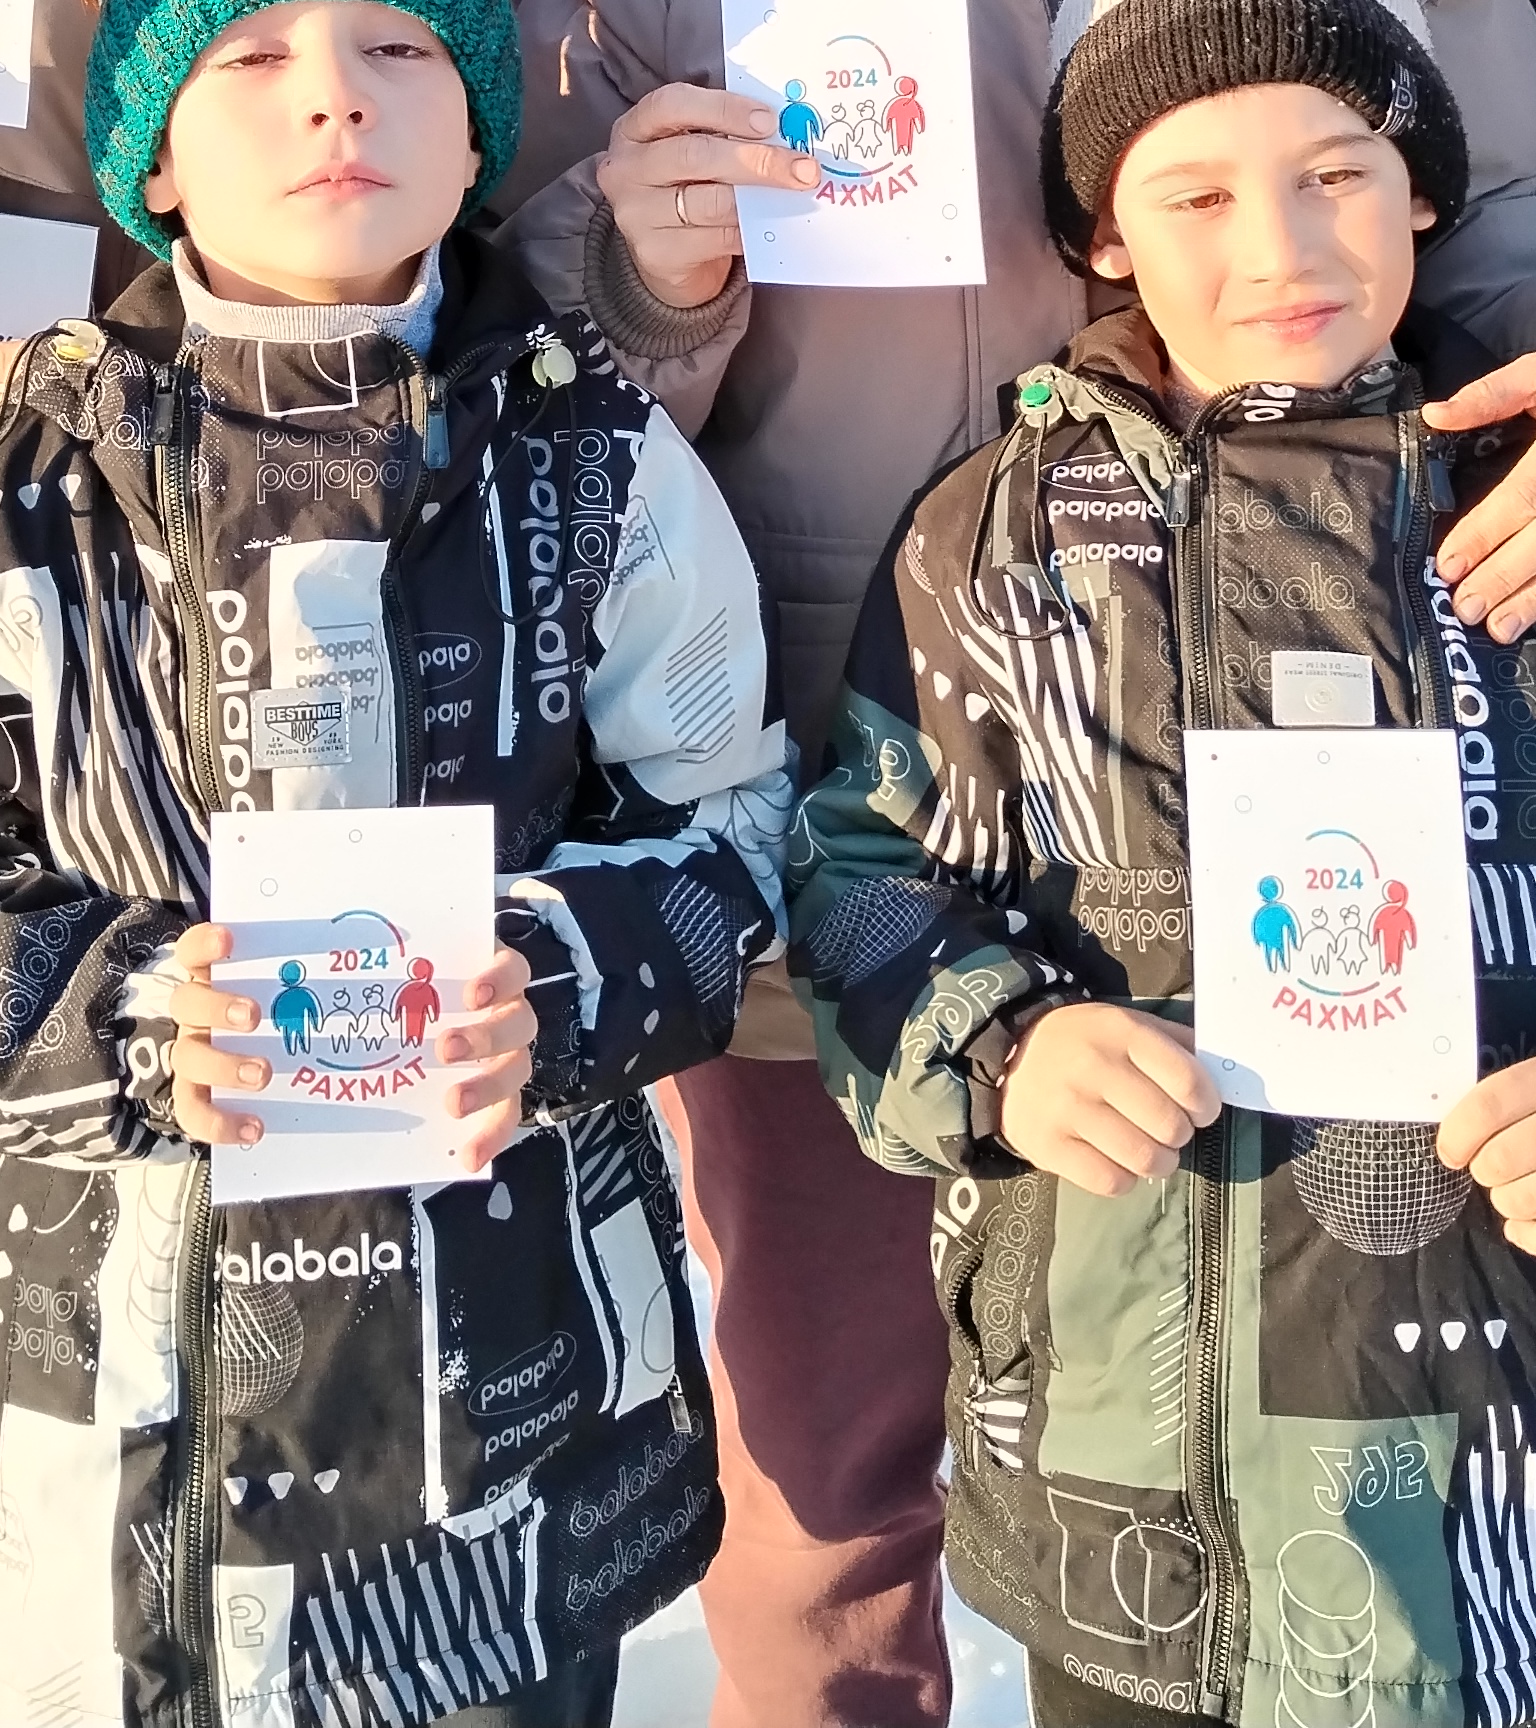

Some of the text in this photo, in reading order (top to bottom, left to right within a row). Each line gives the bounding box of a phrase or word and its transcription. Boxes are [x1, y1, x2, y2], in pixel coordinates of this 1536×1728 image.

[825, 68, 879, 90] 2024
[816, 163, 919, 207] АХМАТ
[265, 703, 342, 723] BESTTIME
[290, 720, 319, 742] BOYS
[265, 748, 299, 756] FASHION
[1305, 868, 1365, 890] 2024
[328, 947, 389, 973] 2024
[1271, 985, 1408, 1032] РАХМАТ
[290, 1054, 428, 1102] РАХМАТ
[216, 1231, 403, 1286] alabala
